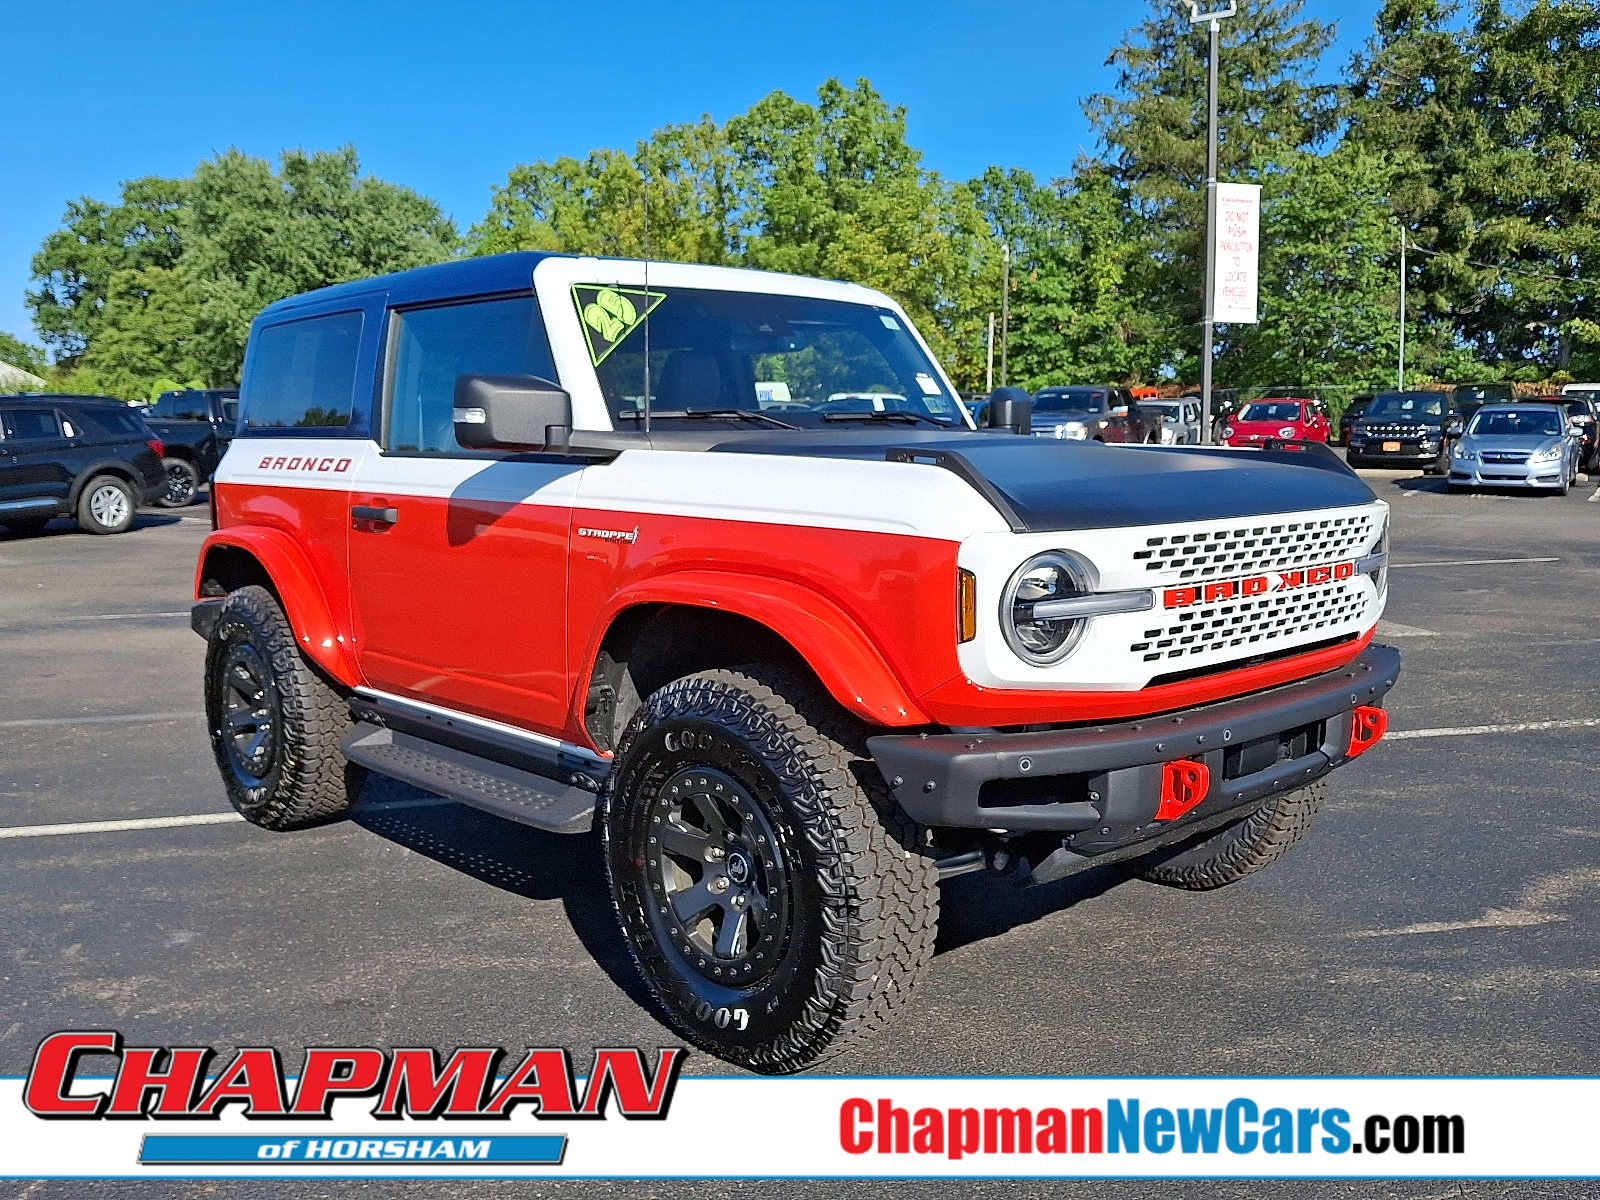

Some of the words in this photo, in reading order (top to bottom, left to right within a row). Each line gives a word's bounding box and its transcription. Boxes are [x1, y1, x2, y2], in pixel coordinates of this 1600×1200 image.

[258, 456, 353, 473] BRONCO
[578, 527, 634, 541] STROPPE
[1163, 562, 1354, 607] BRONCO
